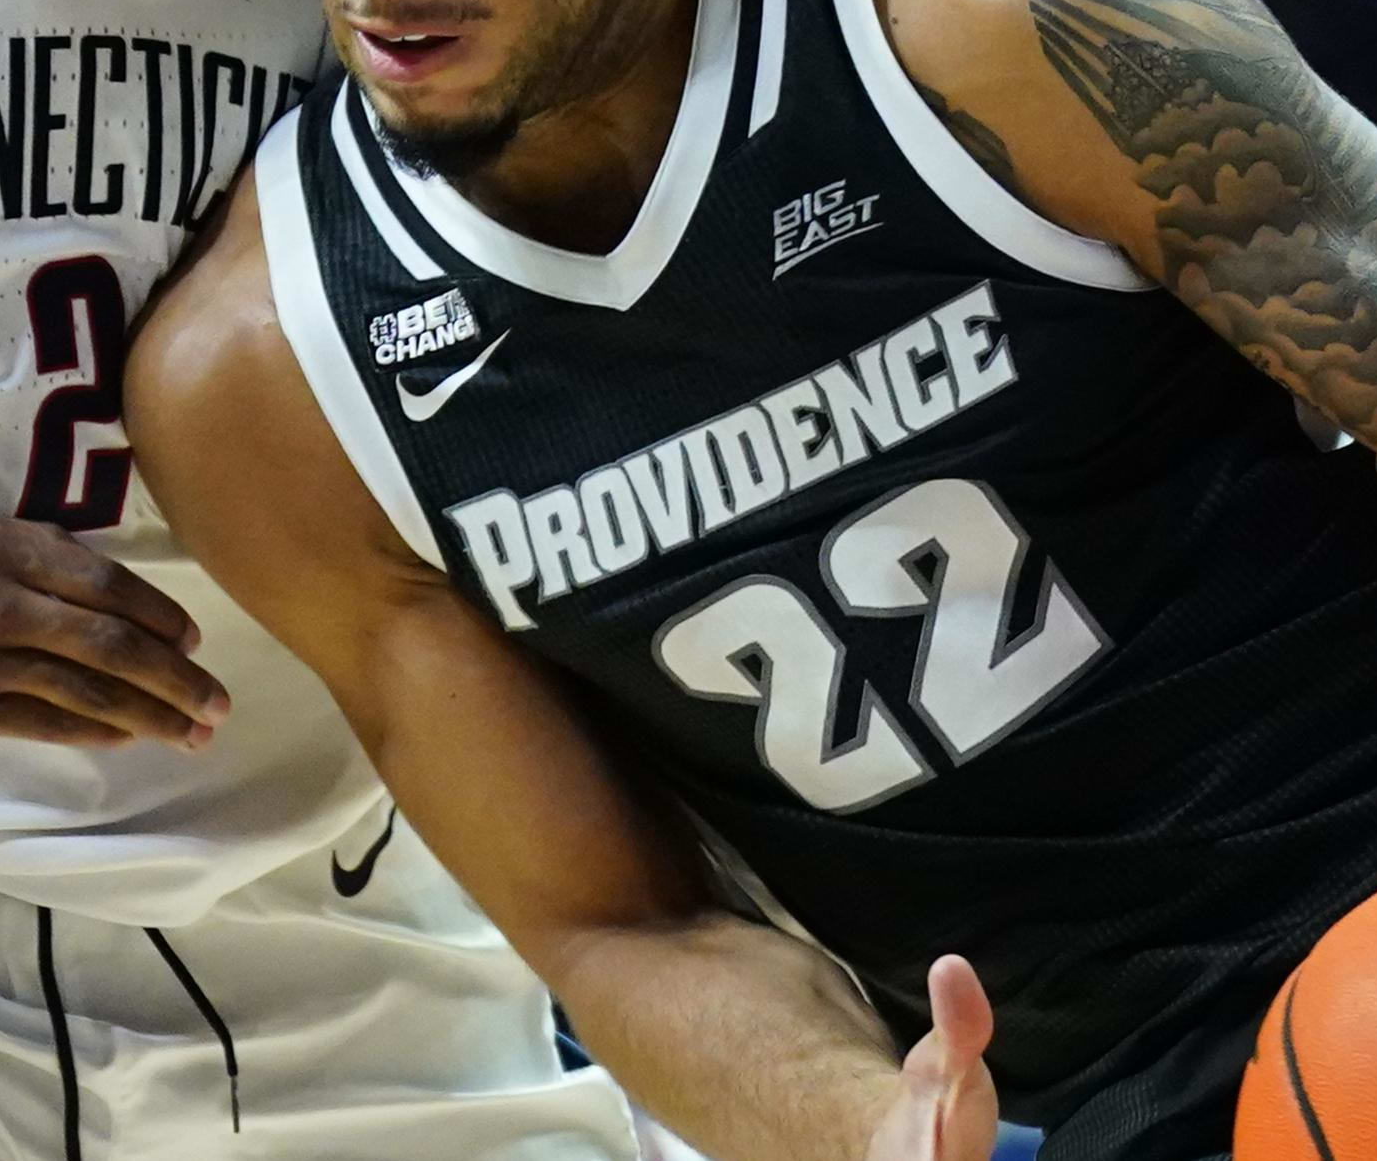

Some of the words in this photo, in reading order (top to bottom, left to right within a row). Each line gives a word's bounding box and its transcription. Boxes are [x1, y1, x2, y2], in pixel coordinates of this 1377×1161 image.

[773, 179, 846, 237] BIG
[774, 194, 880, 263] EAST
[15, 254, 132, 532] 2
[375, 314, 475, 365] CHANG
[442, 279, 1019, 631] PROVIDENCE
[651, 478, 1115, 814] 22
